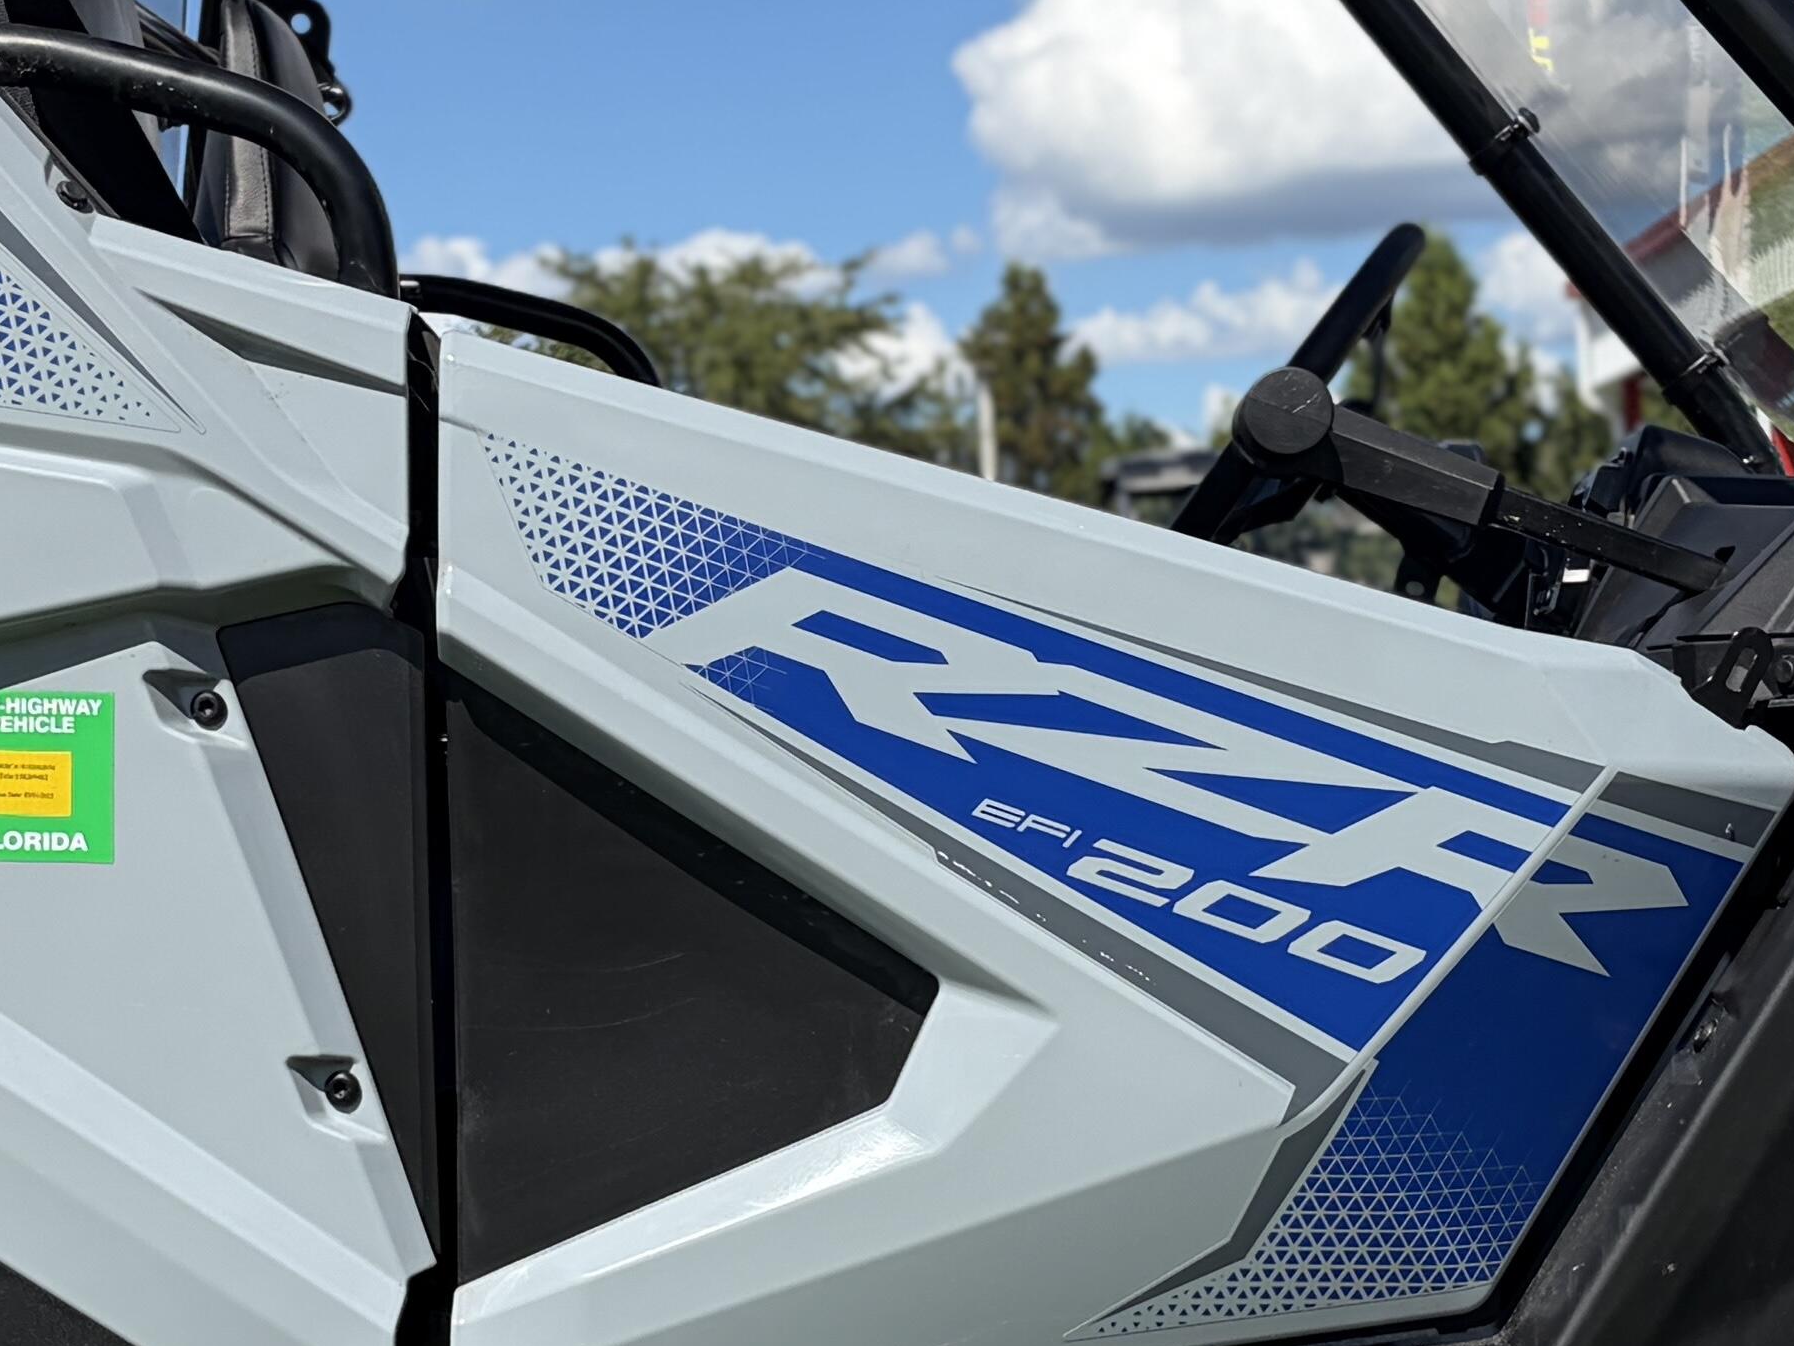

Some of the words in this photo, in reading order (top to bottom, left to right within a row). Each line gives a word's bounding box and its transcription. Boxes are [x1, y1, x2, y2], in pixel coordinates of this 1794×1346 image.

[640, 568, 1689, 977] RZR
[970, 797, 1081, 849] EFI
[1066, 839, 1427, 985] 200
